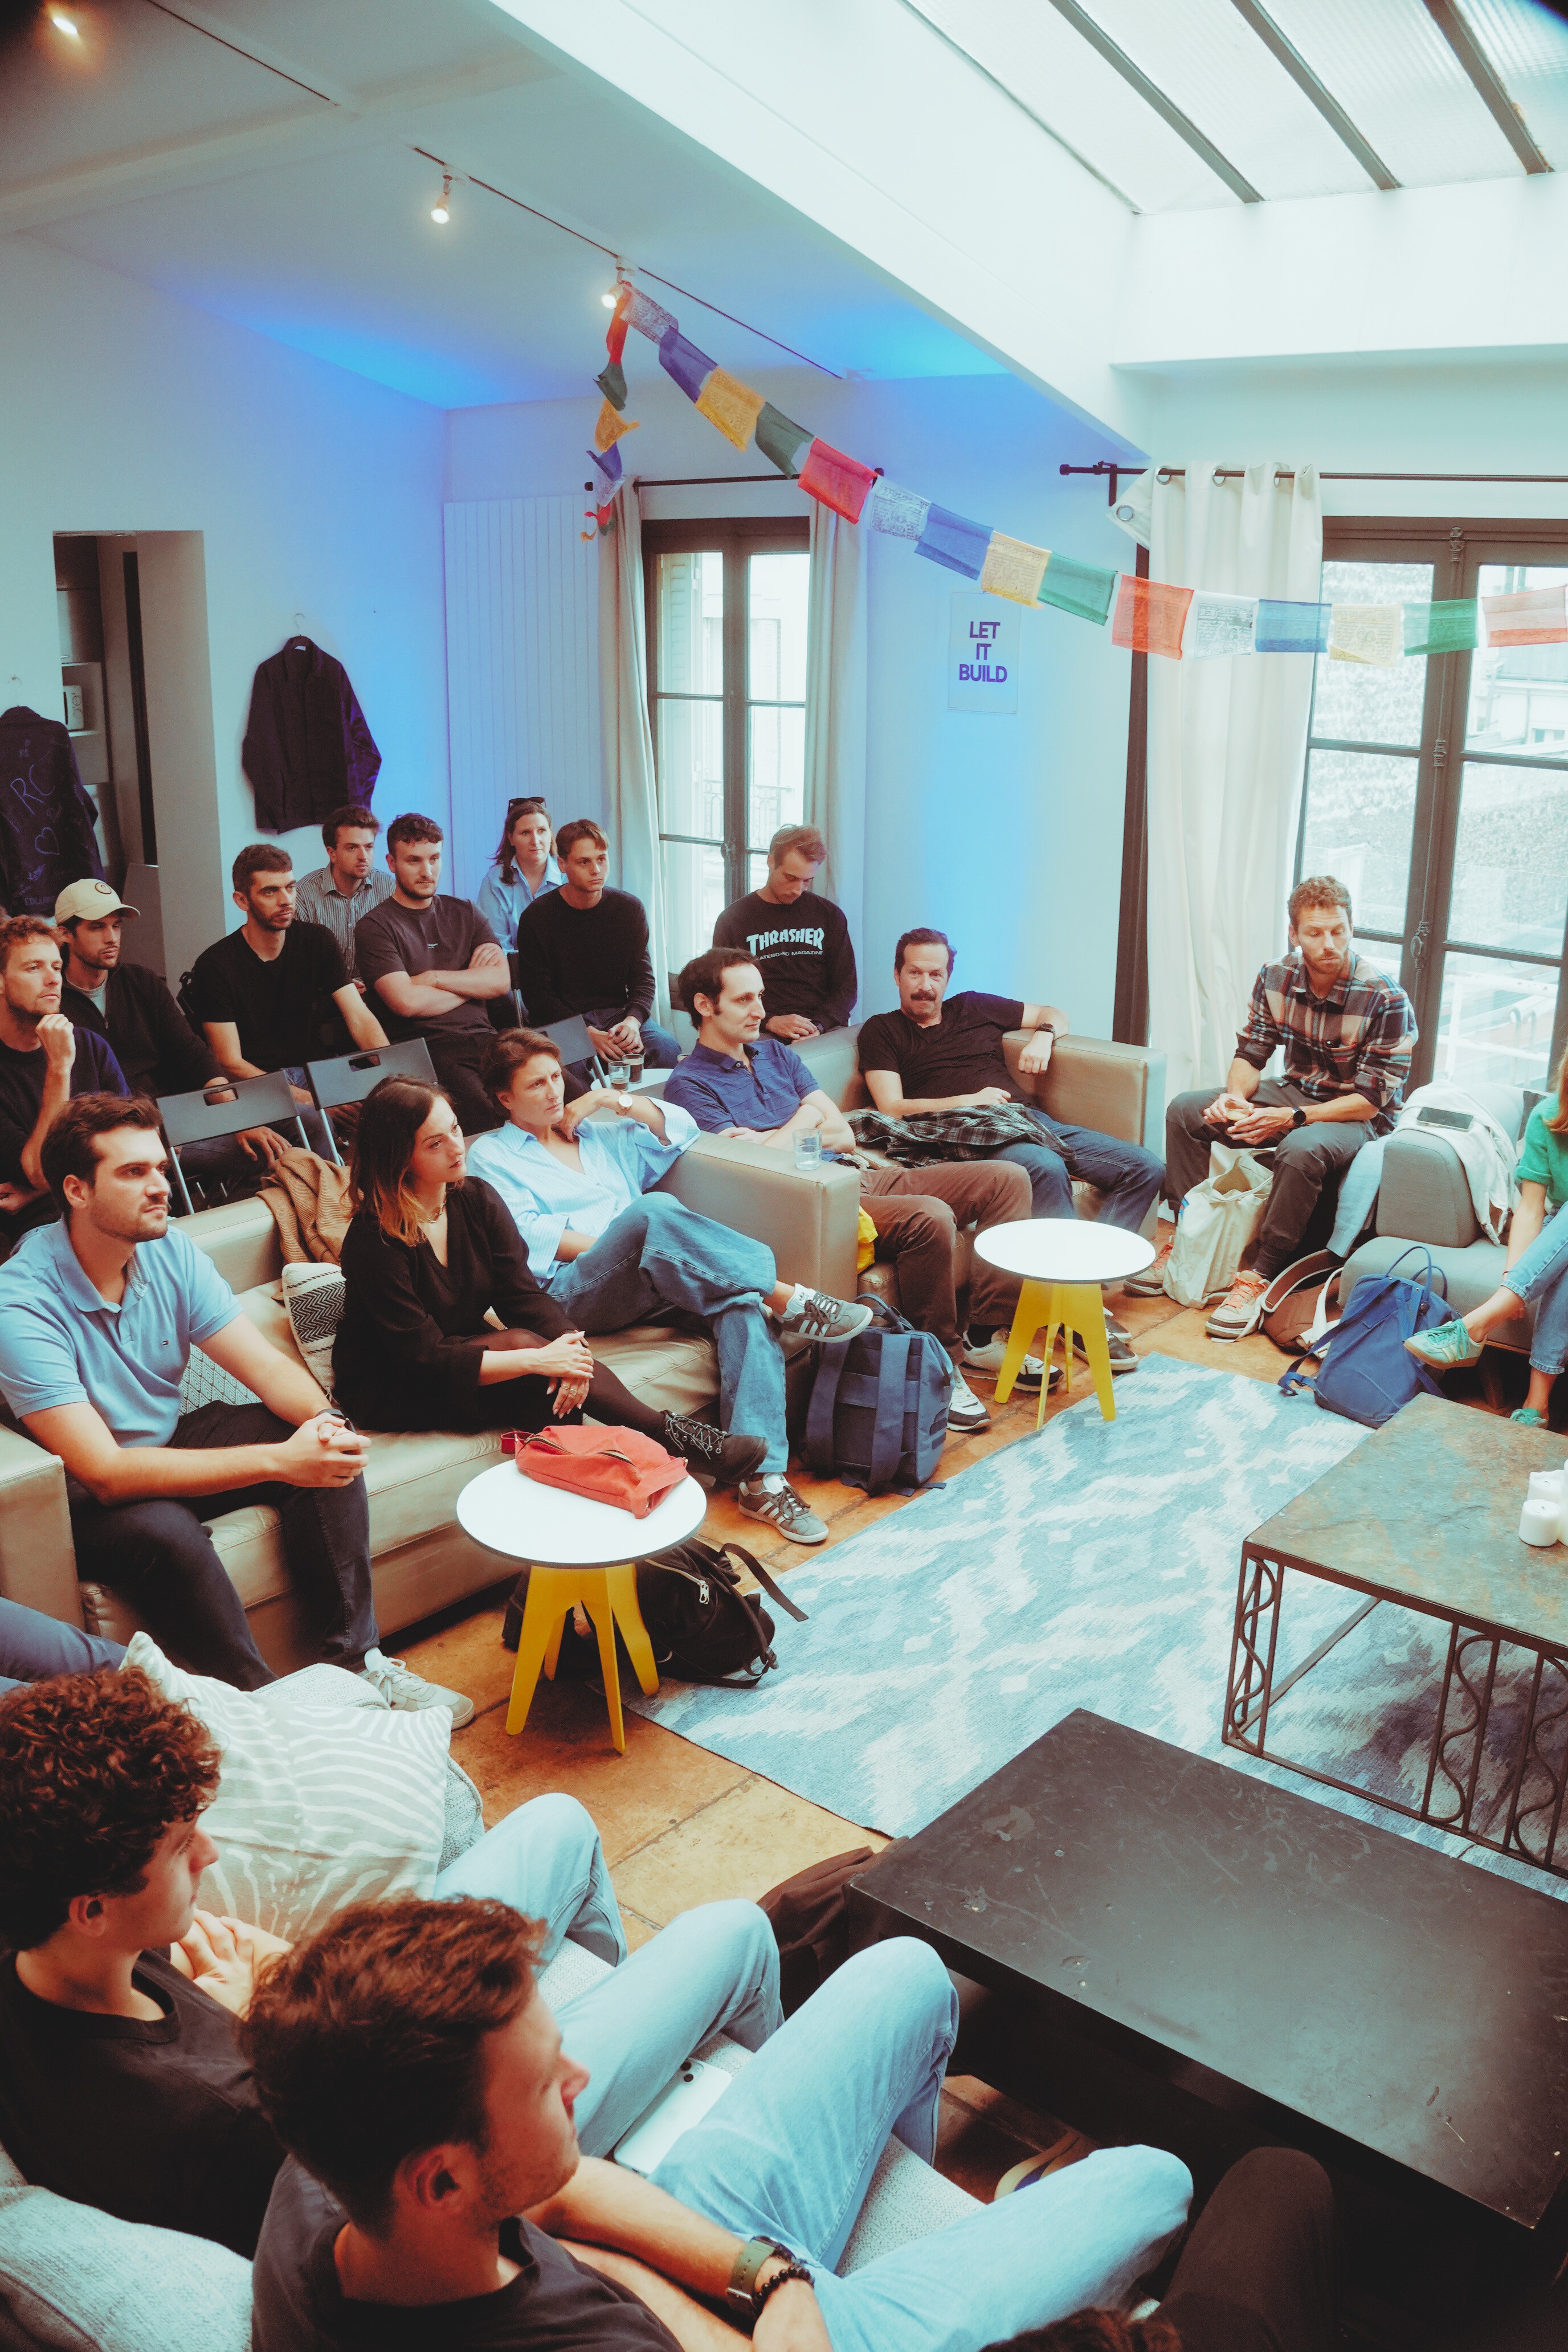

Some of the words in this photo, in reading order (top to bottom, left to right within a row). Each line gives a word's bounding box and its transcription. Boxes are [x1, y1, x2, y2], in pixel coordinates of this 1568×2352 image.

[969, 620, 1001, 639] LET
[975, 643, 992, 660] IT
[959, 663, 1007, 683] BUILD
[746, 927, 825, 957] THRASHER
